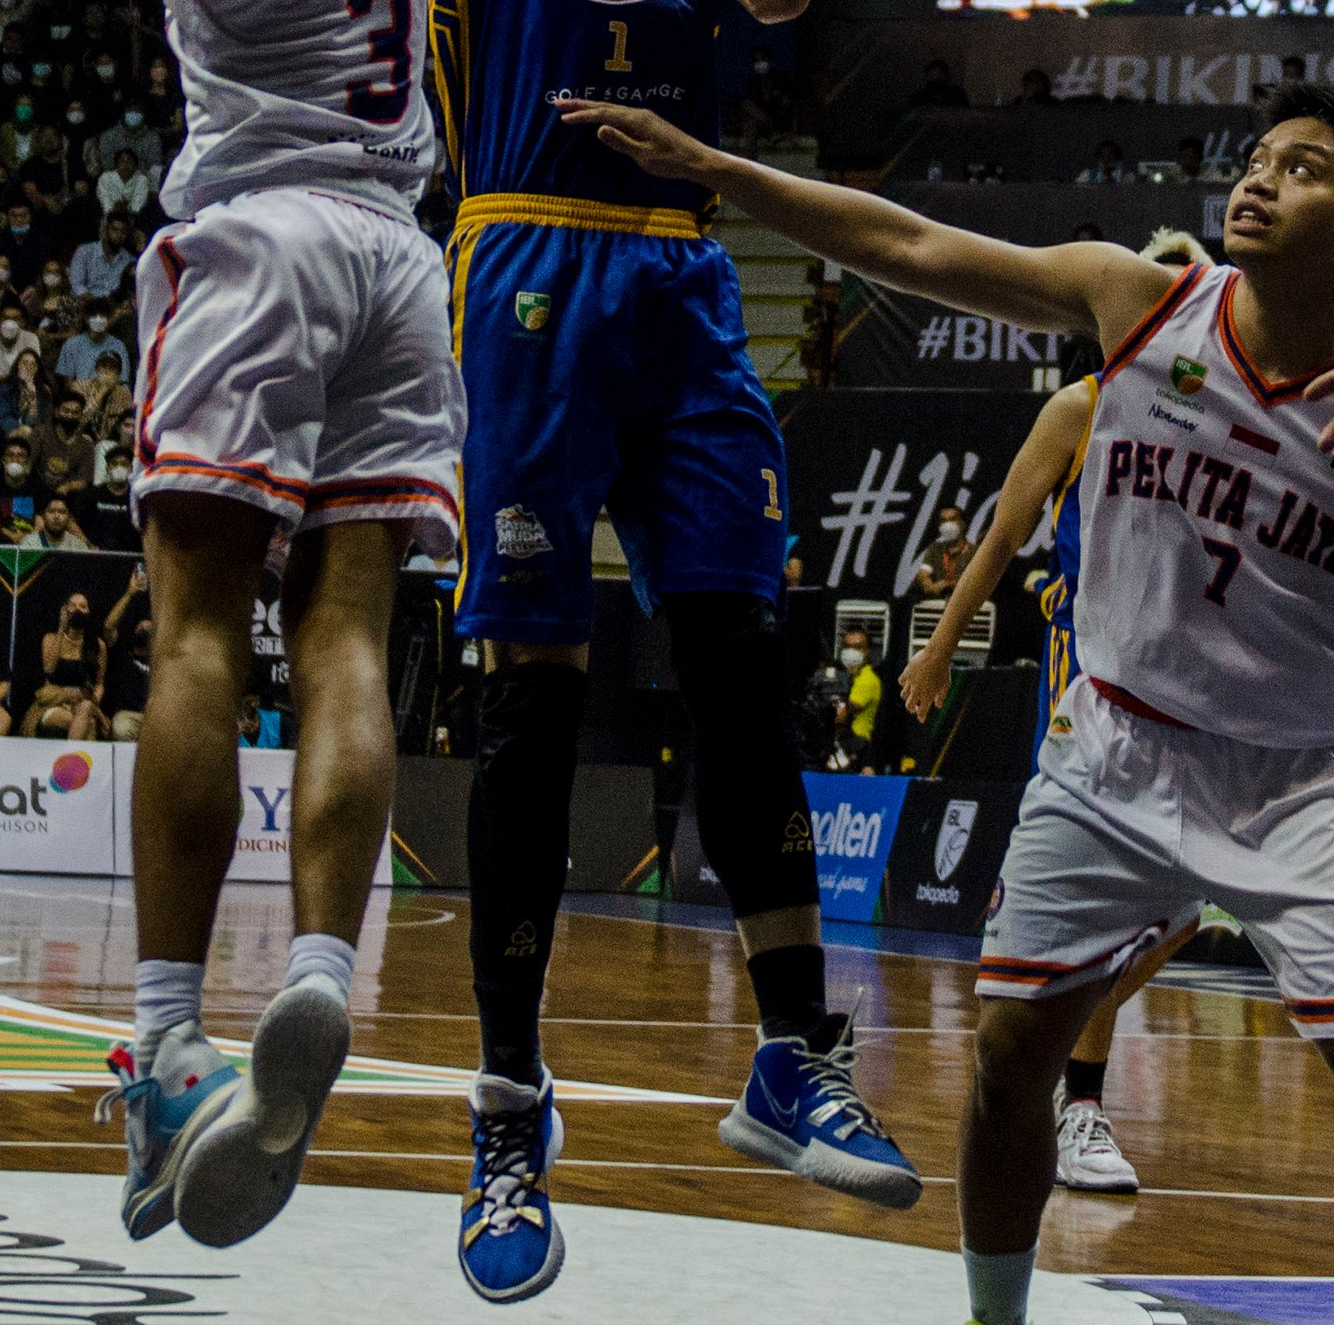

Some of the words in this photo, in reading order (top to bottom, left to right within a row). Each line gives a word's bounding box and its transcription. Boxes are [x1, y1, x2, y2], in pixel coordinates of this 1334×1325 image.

[604, 20, 633, 73] 1
[760, 468, 783, 522] 1
[1107, 441, 1252, 530] PELITA
[1201, 536, 1242, 607] 7
